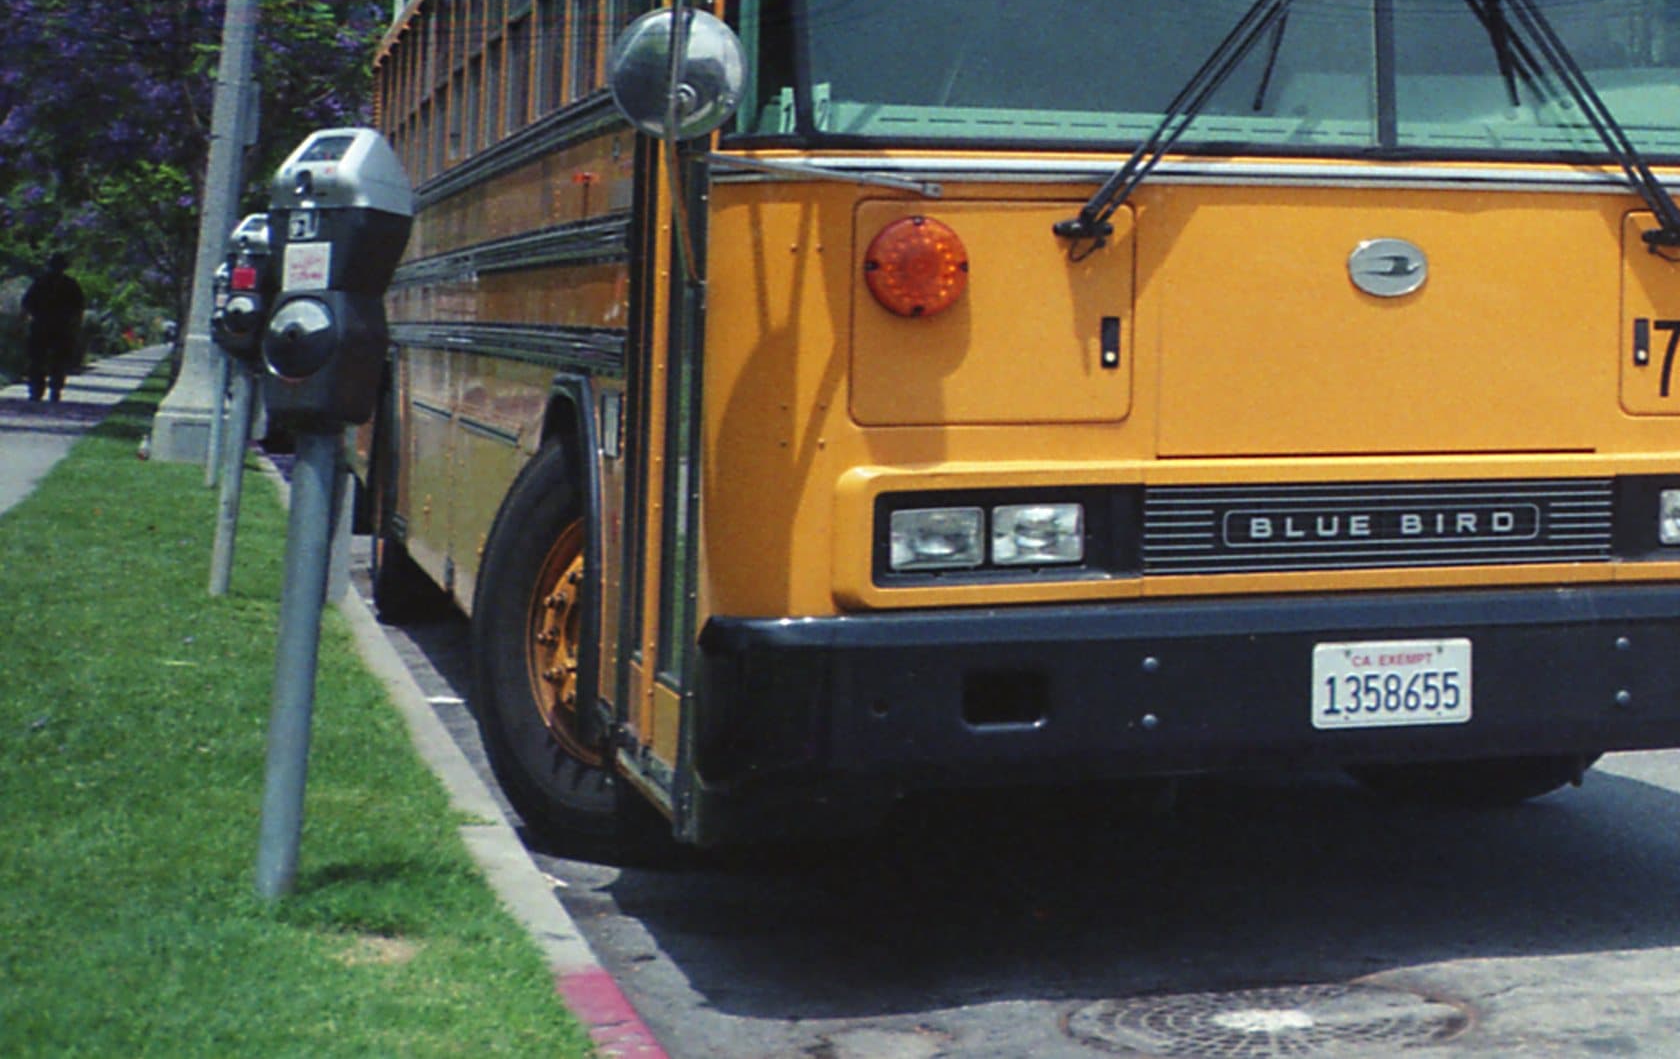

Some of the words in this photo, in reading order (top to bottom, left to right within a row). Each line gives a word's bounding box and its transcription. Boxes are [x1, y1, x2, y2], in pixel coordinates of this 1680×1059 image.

[1250, 515, 1371, 538] BLUE
[1401, 512, 1514, 533] BIRD
[1352, 655, 1371, 667] CA
[1379, 653, 1433, 666] EXEMPT
[1323, 671, 1461, 715] 1358655
